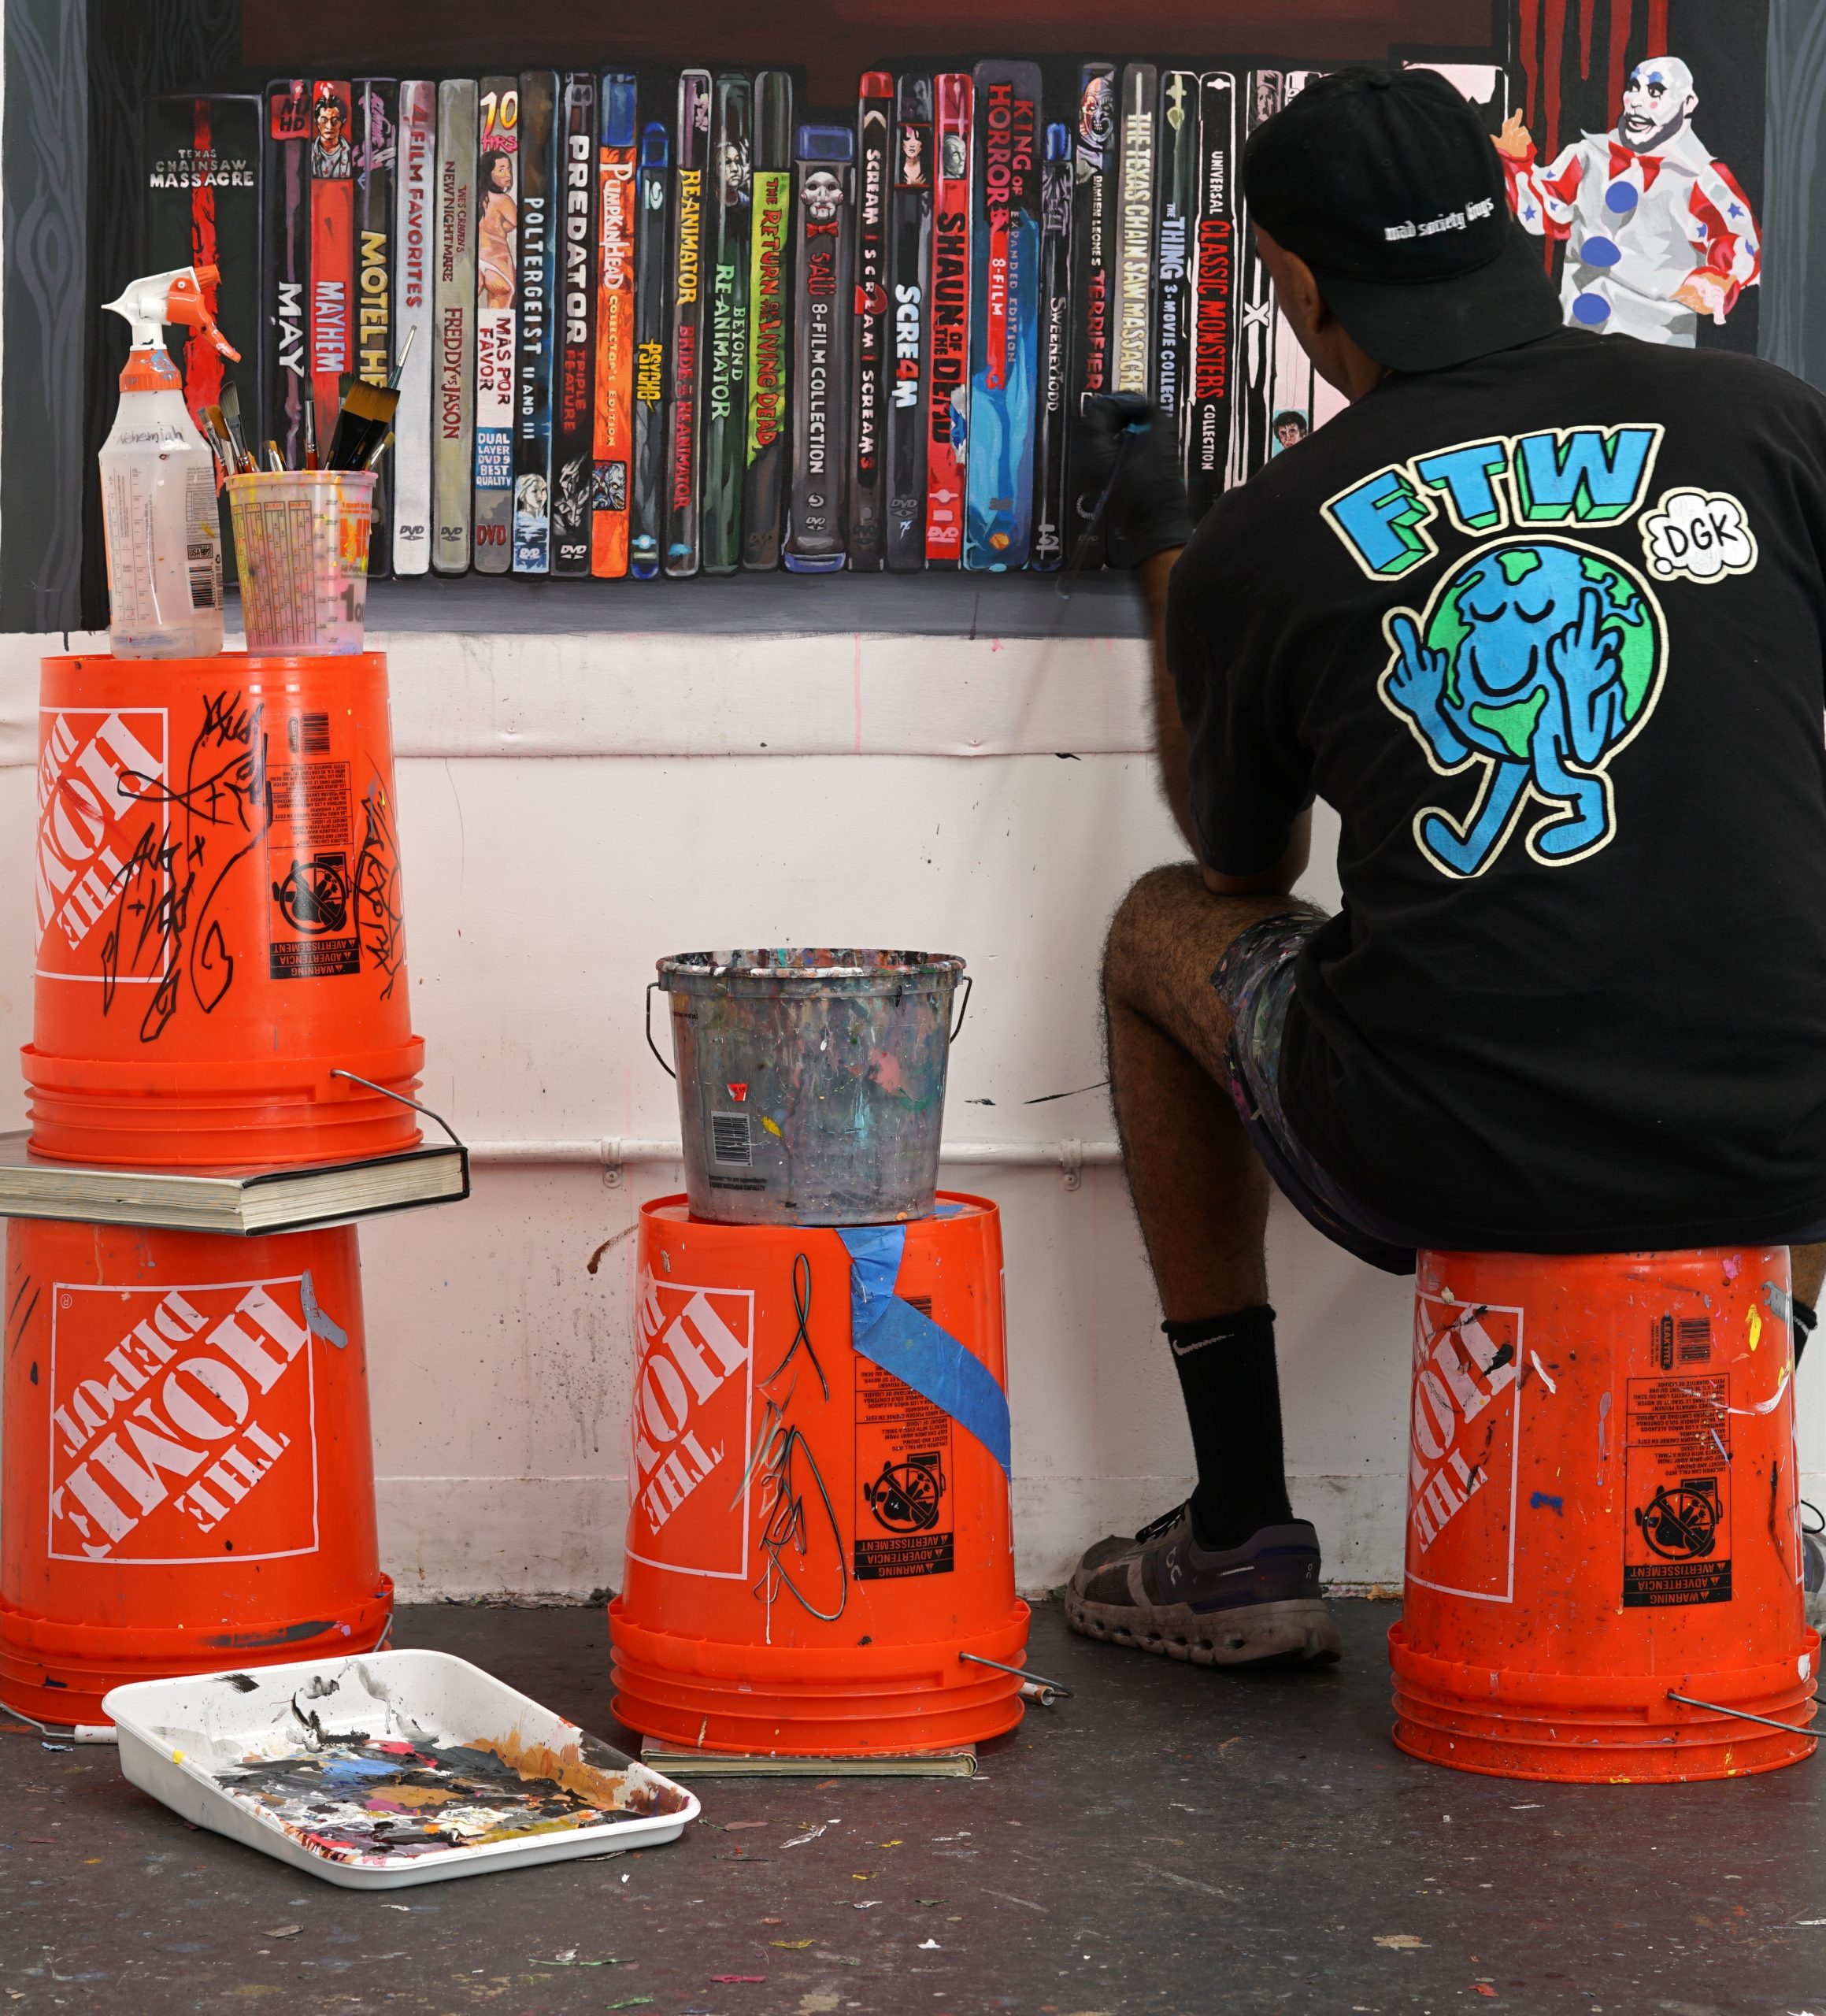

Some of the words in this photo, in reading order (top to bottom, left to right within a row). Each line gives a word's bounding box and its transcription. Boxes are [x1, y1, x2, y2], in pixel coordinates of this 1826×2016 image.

[409, 103, 428, 125] 4
[480, 90, 518, 133] 10
[1012, 100, 1034, 172] KING
[1126, 112, 1151, 146] THE
[155, 159, 246, 172] CHAINSAW
[178, 149, 217, 159] TEXAS
[408, 131, 425, 182] FILM
[481, 135, 518, 154] HRS
[987, 83, 1012, 232] HORROR
[150, 171, 254, 188] MASSACRE
[457, 184, 467, 208] WES
[766, 177, 778, 206] THE
[862, 148, 881, 225] SCREAM
[1011, 176, 1023, 196] OF
[1093, 175, 1102, 217] DAMIEN
[1124, 149, 1150, 202] TEXAS
[1209, 150, 1224, 215] UNIVERSAL
[1123, 204, 1150, 259] CHAIN
[1167, 202, 1176, 218] THE
[406, 188, 424, 308] FAVORITES
[566, 135, 590, 345] PREDATOR
[759, 207, 783, 296] RETURN
[1009, 211, 1020, 290] EXPANDED
[1091, 220, 1102, 267] LEONES
[1160, 217, 1186, 280] THING
[1197, 220, 1232, 295] CLASSIC
[360, 230, 388, 344] MOTEL
[523, 198, 544, 354] POLTERGEIST
[932, 211, 966, 328] SHAUN
[949, 332, 962, 352] OF
[991, 258, 1007, 315] 8-FILM
[1123, 261, 1149, 300] SAW
[279, 280, 305, 379] MAY
[315, 280, 346, 372] MAYHEM
[442, 307, 463, 377] FREDDY
[810, 302, 828, 364] 8-FILM
[934, 328, 949, 356] THE
[1007, 297, 1018, 363] EDITION
[1049, 297, 1067, 372] SWEENEY
[1085, 269, 1106, 391] TERRIFIER
[1162, 284, 1178, 346] 3-MOVIE
[479, 328, 494, 392] FAVOR
[677, 324, 694, 380] BRIDE
[732, 305, 746, 381] BEYOND
[756, 319, 782, 388] LIVING
[891, 284, 921, 409] SCRE4M
[1118, 302, 1146, 394] MASSACRE
[1195, 299, 1227, 399] MONSTERS
[496, 367, 511, 405] POR
[522, 366, 535, 378] II
[563, 352, 577, 432] FEATURE
[572, 349, 587, 411] TRIPLE
[635, 338, 663, 413] PSYCHO
[1047, 372, 1065, 412] TODD
[441, 384, 462, 439] JASON
[521, 384, 534, 416] AND
[606, 390, 617, 447] EDITION
[754, 392, 778, 447] DEAD
[809, 365, 827, 474] COLLECTION
[857, 369, 874, 454] SCREAM
[478, 432, 511, 445] DUAL
[478, 445, 510, 455] LAYER
[522, 422, 535, 439] III
[1201, 403, 1216, 471] COLLECTION
[476, 476, 512, 487] QUALITY
[480, 465, 509, 476] BEST
[861, 455, 875, 469] 3
[1324, 425, 1660, 577] FTW
[399, 525, 425, 535] DVD
[440, 526, 463, 536] DVD
[476, 524, 507, 546] DVD
[560, 544, 587, 555] DVD
[1664, 513, 1739, 558] DGK
[341, 584, 354, 622] 1
[272, 938, 347, 954] AVERTISSEMENT
[279, 951, 342, 965] ADVERTENCIA
[291, 965, 335, 976] WARNING
[54, 1291, 209, 1458] DEPOT
[52, 1285, 308, 1558] HOME
[173, 1420, 291, 1534] THE
[641, 1429, 724, 1536] THE
[860, 1536, 939, 1551] AVERTISSEMENT
[867, 1549, 933, 1565] ADVERTENCIA
[878, 1564, 925, 1577] WARNING
[1630, 1562, 1715, 1577] AVERTISSEMENT
[1637, 1577, 1708, 1591] ADVERTENCIA
[1650, 1591, 1699, 1605] WARNING
